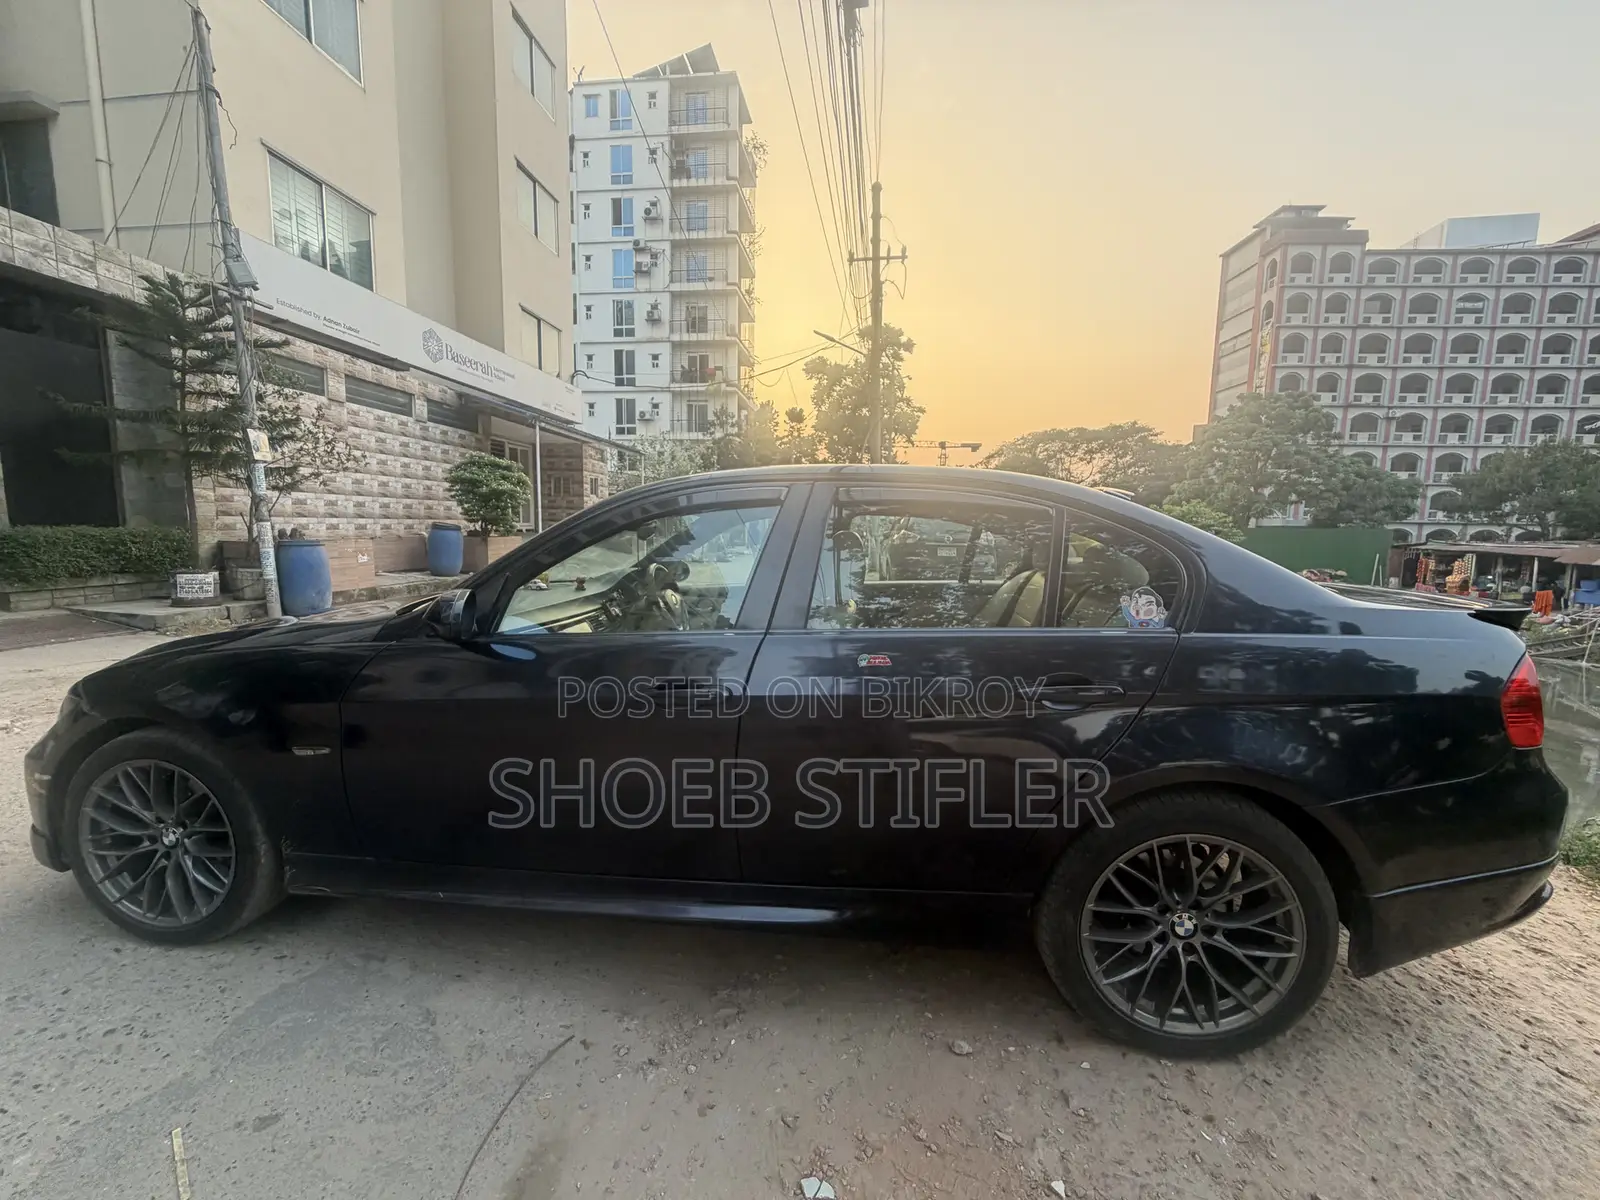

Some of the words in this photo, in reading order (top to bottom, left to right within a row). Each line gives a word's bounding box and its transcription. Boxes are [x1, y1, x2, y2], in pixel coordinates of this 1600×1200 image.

[276, 297, 312, 317] Established
[322, 316, 343, 329] Adnan
[445, 342, 493, 377] Baseerah
